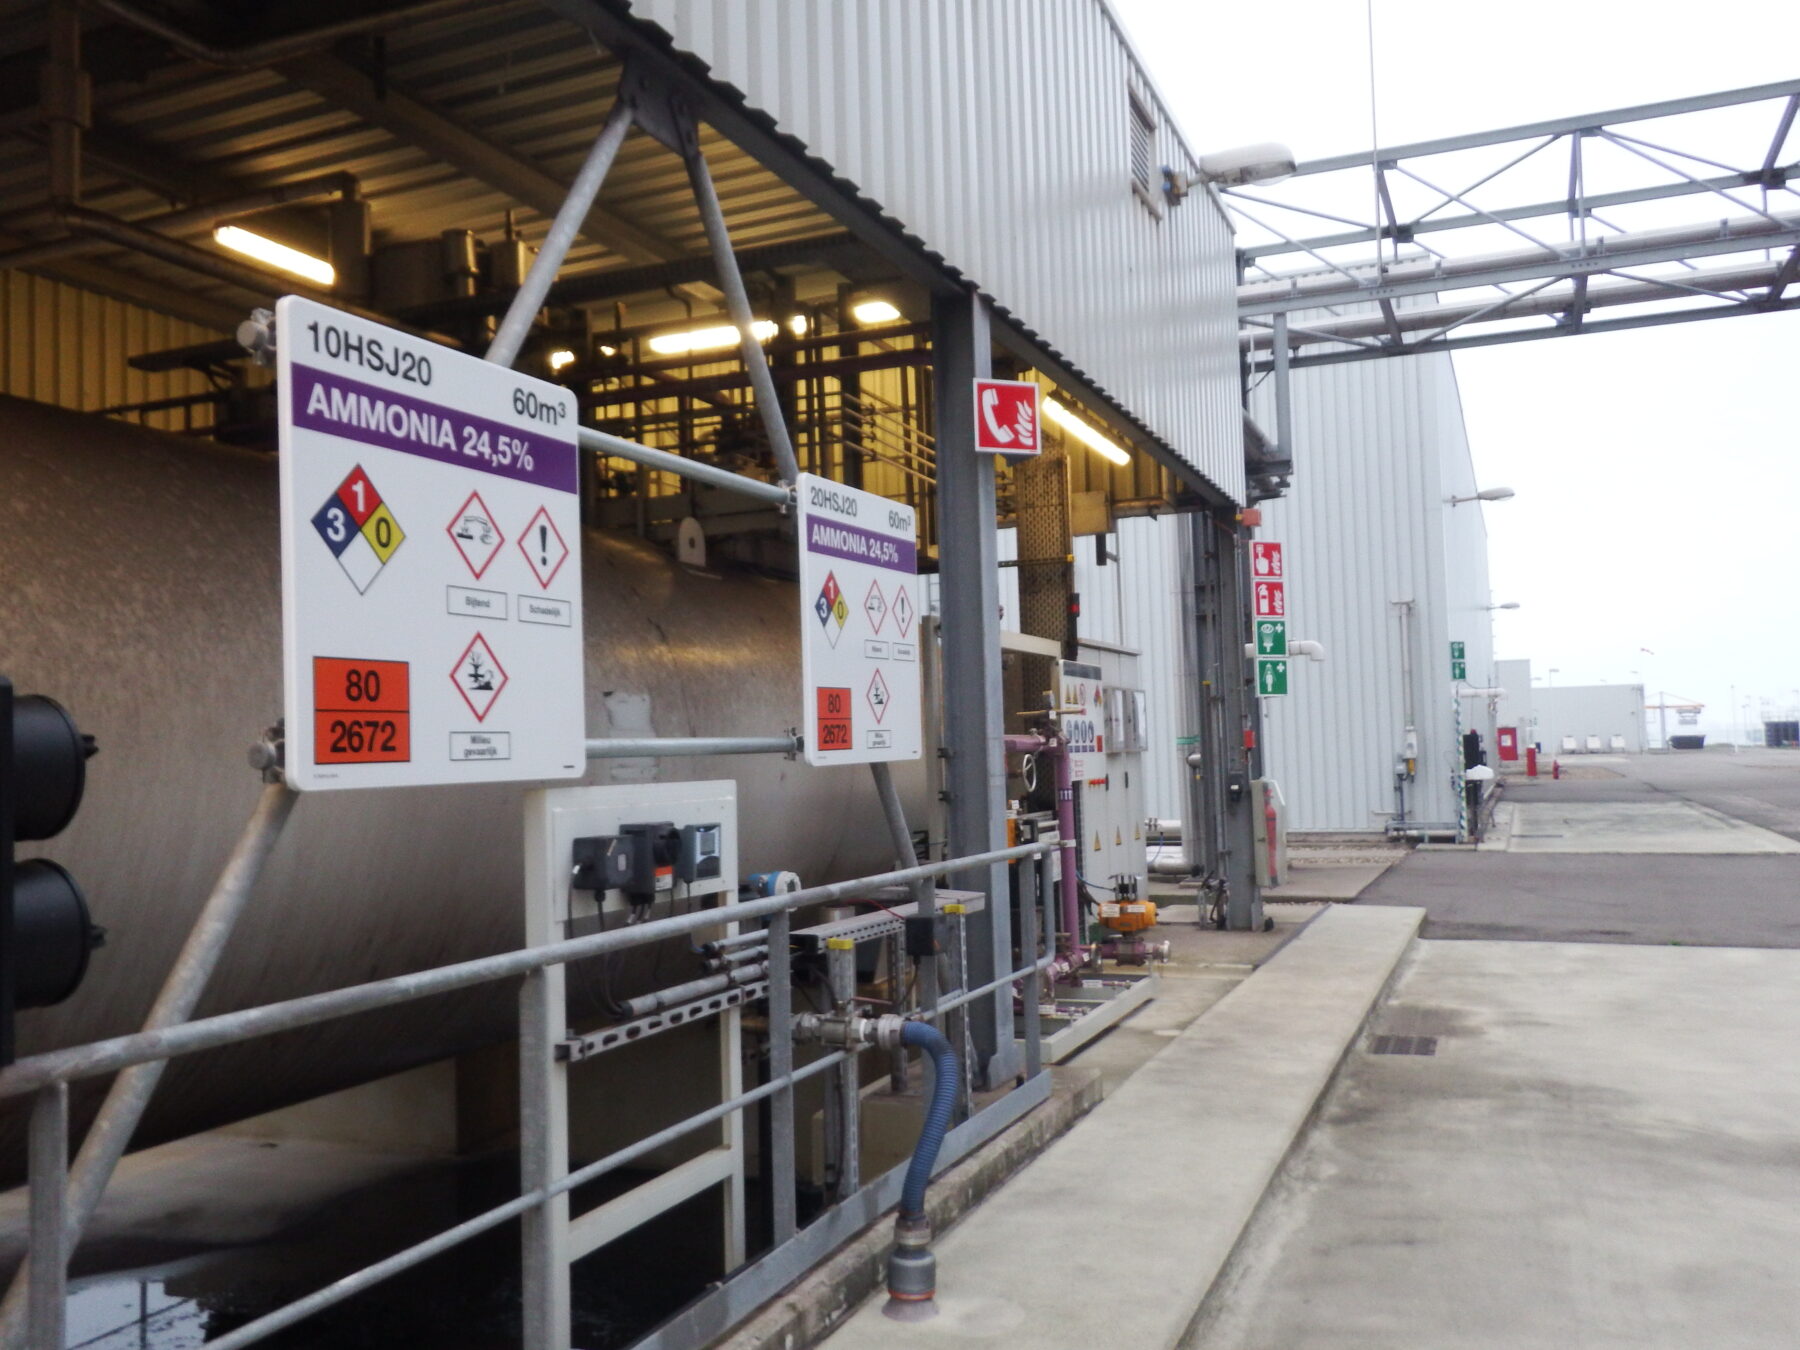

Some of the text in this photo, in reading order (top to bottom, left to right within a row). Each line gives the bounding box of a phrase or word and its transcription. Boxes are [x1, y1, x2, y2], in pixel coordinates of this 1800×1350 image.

[307, 320, 432, 387] 10HSJ20
[306, 381, 534, 472] AMMONIA 24,5%
[352, 480, 366, 513] 1
[810, 485, 858, 518] 20HSJ20
[326, 507, 347, 543] 3
[375, 516, 391, 549] 0
[812, 523, 899, 563] AMMONIA 24,5%
[828, 579, 835, 600] 1
[820, 597, 828, 618] 3
[837, 600, 844, 620] 0
[345, 668, 381, 702] 80
[828, 693, 841, 713] 80
[330, 720, 397, 753] 2672
[823, 724, 848, 744] 2672
